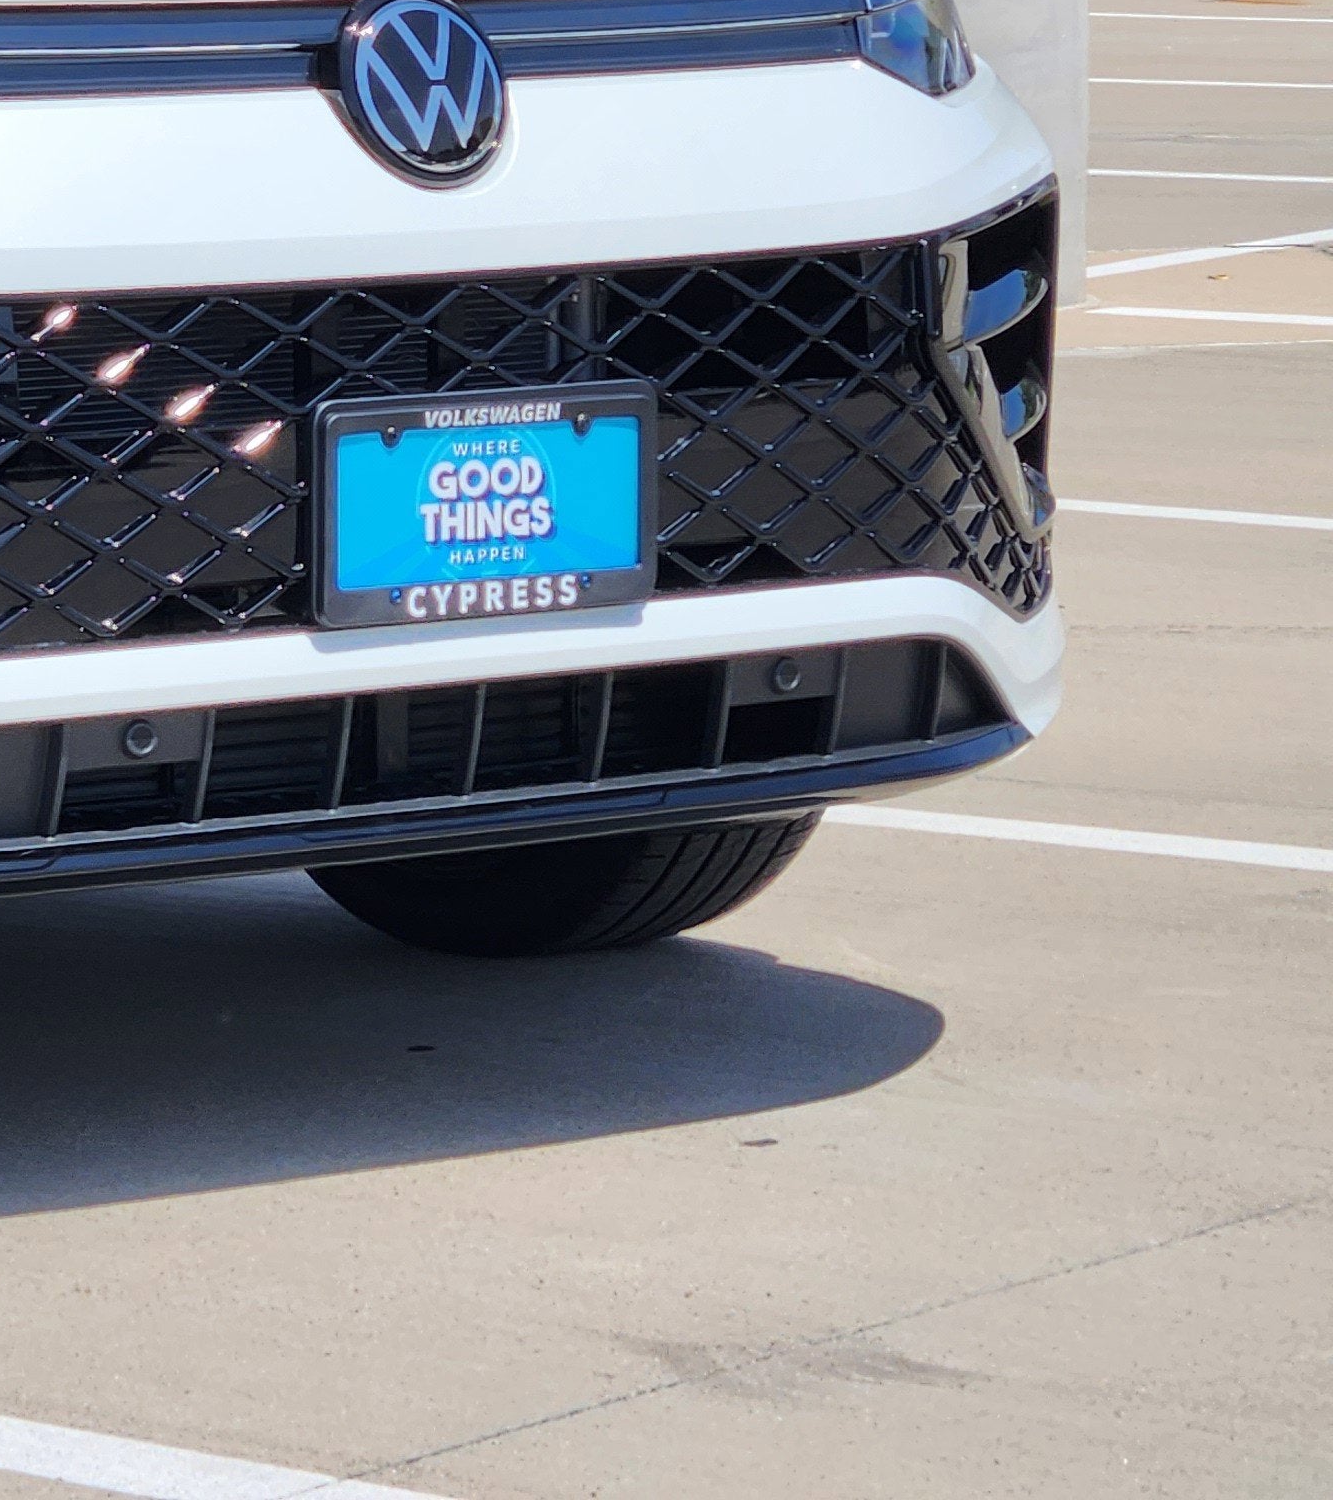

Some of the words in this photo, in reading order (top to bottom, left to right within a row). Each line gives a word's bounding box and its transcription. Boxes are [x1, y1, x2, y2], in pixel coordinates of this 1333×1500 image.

[424, 402, 562, 429] VOLKSWAGEN
[452, 439, 522, 457] WHERE
[428, 456, 545, 500] GOOD
[419, 496, 554, 543] THINGS
[449, 546, 526, 565] HAPPEN
[407, 573, 578, 619] CYPRESS
